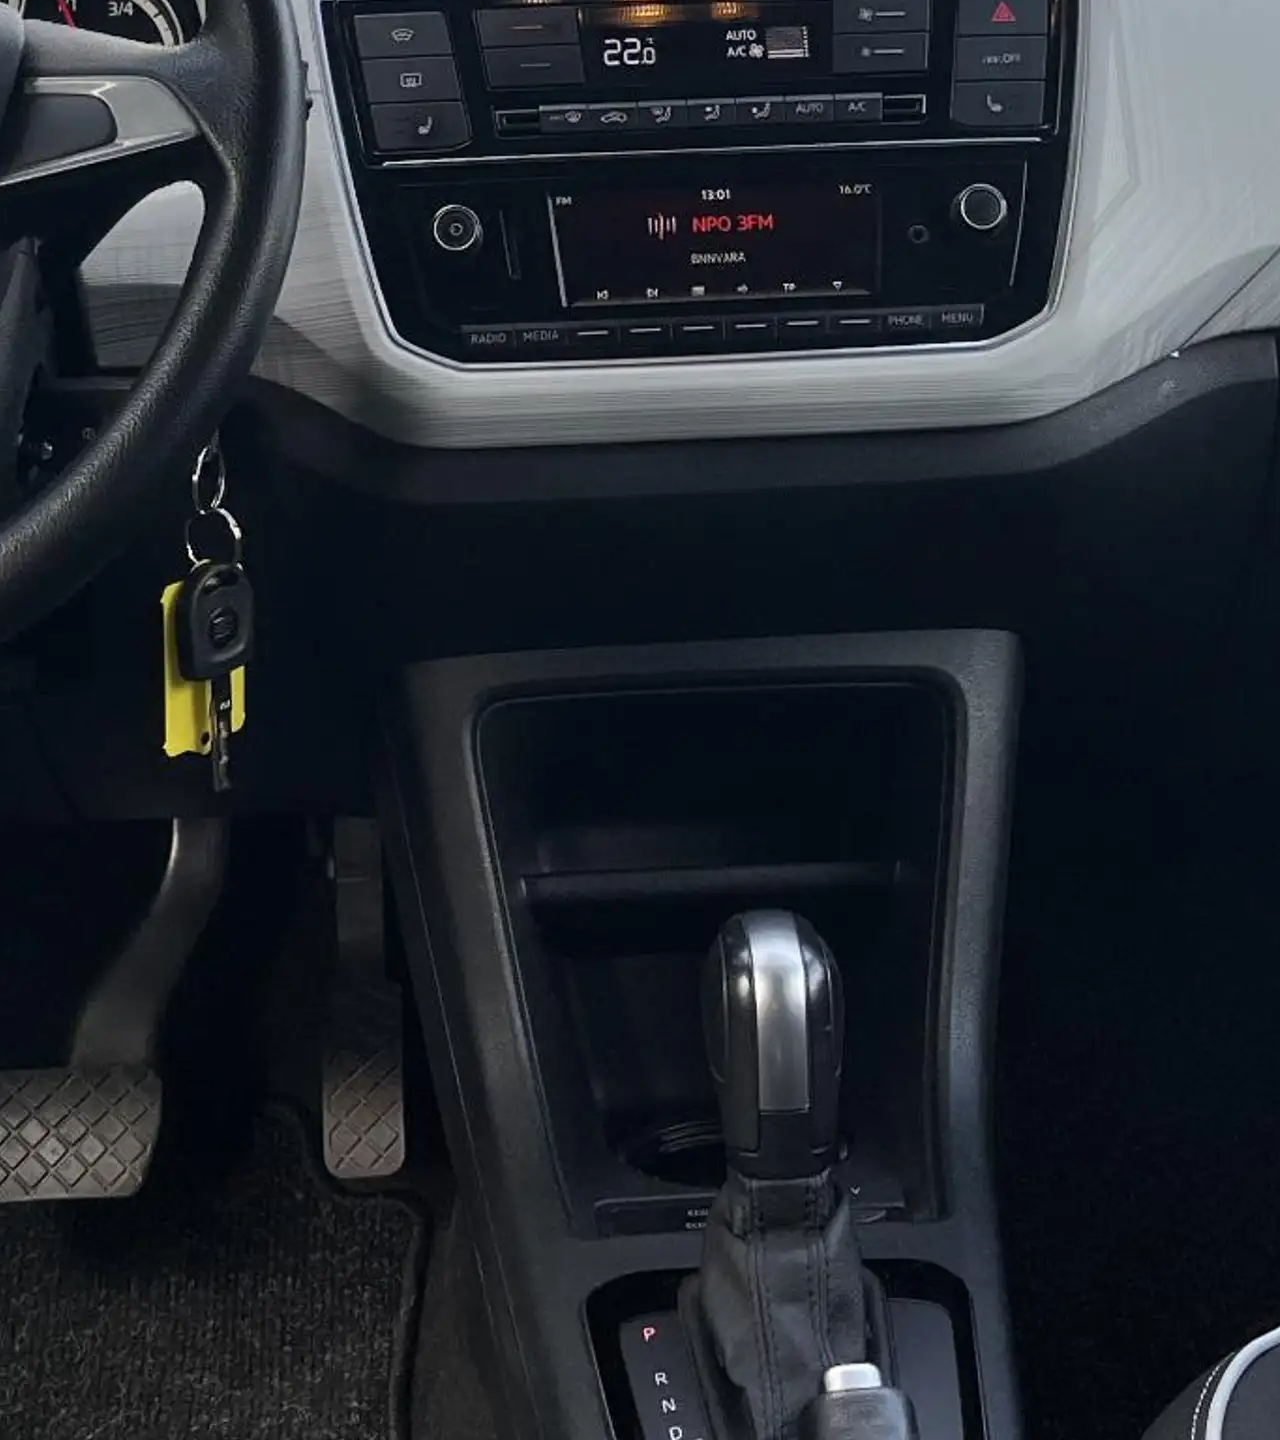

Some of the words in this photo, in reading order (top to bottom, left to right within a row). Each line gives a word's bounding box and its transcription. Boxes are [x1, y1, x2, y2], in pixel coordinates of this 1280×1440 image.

[108, 1, 134, 17] 3/4
[726, 29, 757, 41] AUTO
[726, 46, 748, 58] A/C
[795, 102, 823, 114] AUTO
[847, 101, 867, 112] A/C
[701, 189, 731, 201] 13:01
[692, 215, 731, 232] NPO
[737, 213, 774, 231] 3FM
[941, 311, 973, 324] MENU
[471, 332, 507, 345] RADIO
[523, 329, 559, 342] MEDIA
[643, 1326, 656, 1342] P
[655, 1372, 668, 1385] R
[662, 1398, 676, 1412] N
[669, 1426, 683, 1440] D
